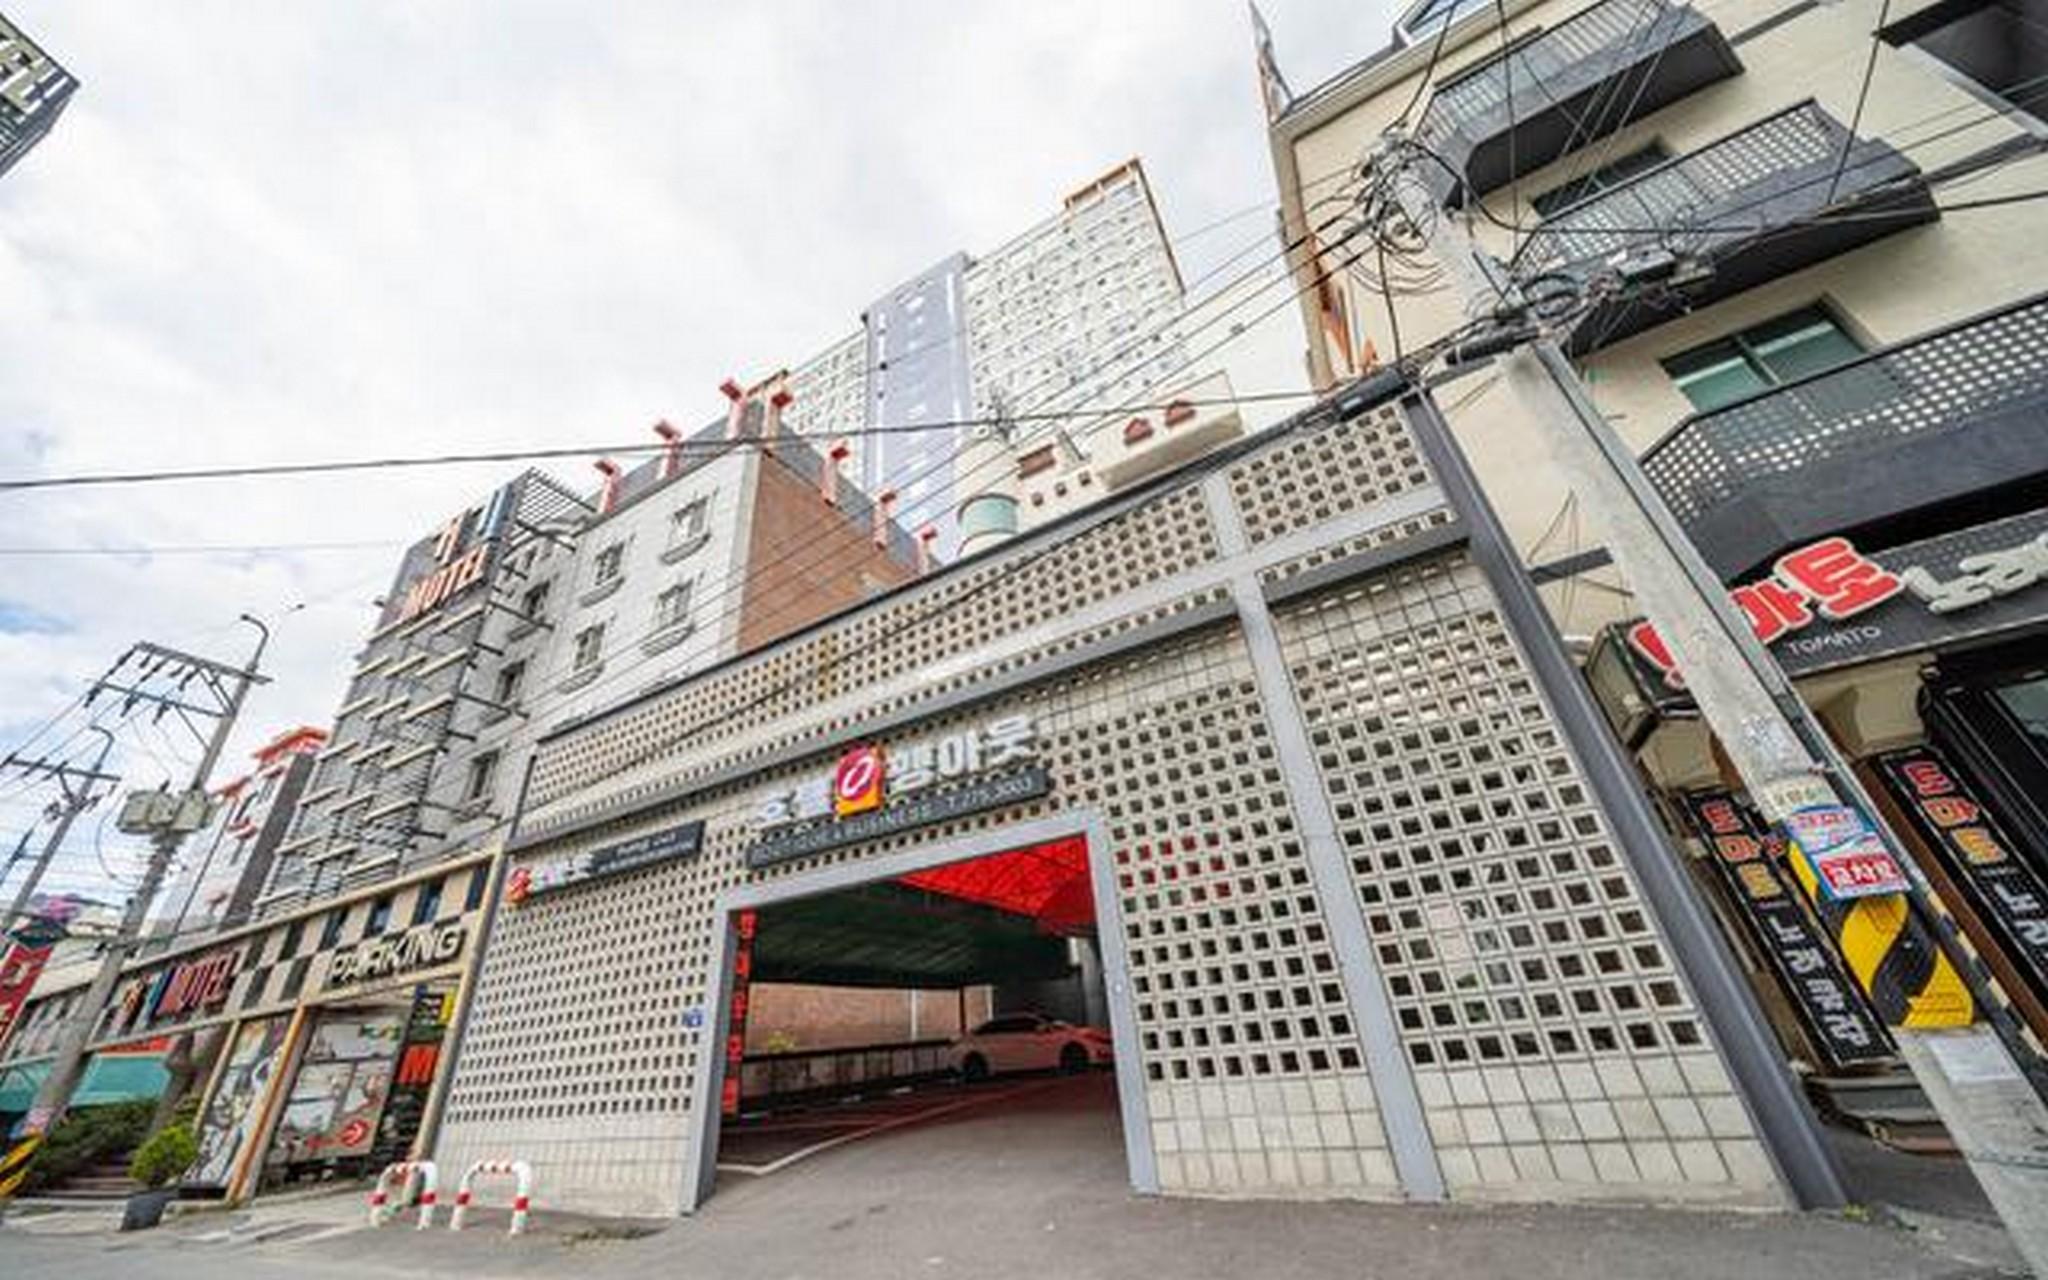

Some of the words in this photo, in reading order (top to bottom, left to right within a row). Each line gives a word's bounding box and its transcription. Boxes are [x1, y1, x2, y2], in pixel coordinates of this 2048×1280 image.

[1787, 624, 1883, 657] TOMATO
[1701, 799, 1783, 899] 토마토
[1901, 760, 2009, 866] 토마토
[328, 923, 464, 983] PARKING
